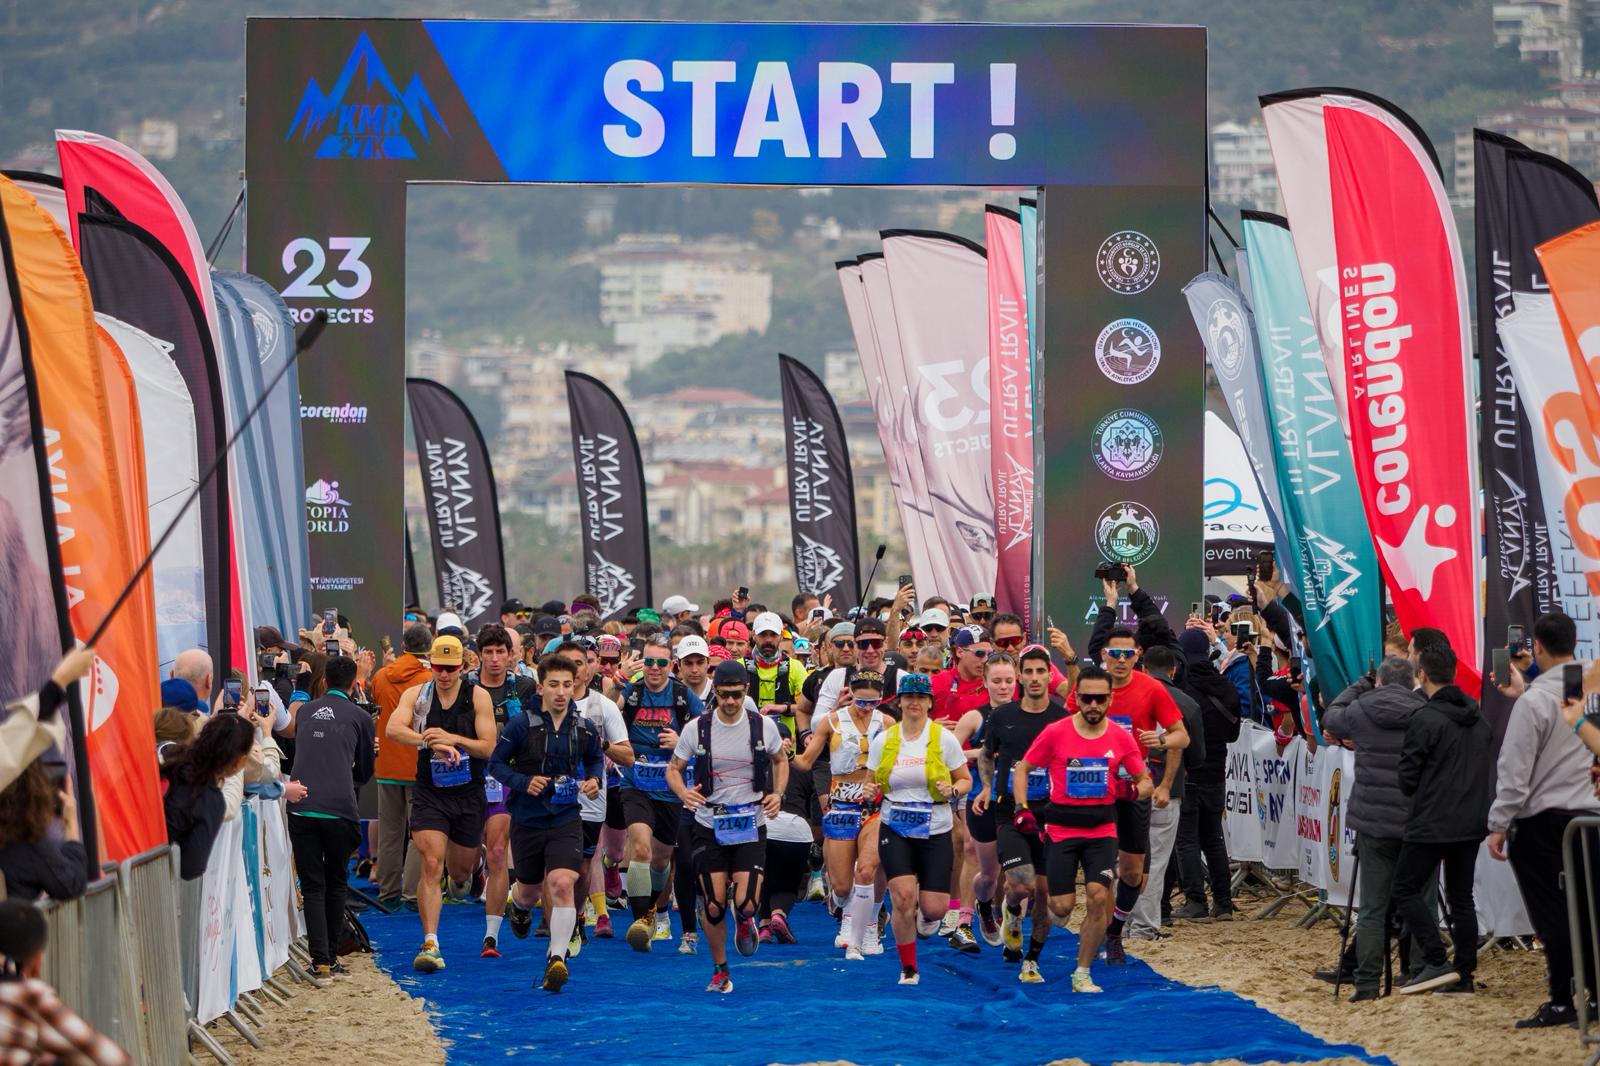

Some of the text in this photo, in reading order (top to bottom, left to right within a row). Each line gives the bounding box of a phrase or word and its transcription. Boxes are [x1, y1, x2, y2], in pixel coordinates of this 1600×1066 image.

[602, 59, 1017, 160] START !
[338, 104, 404, 135] KMR
[338, 136, 386, 159] 27K
[280, 237, 372, 300] 23
[288, 308, 374, 324] ROECTS
[300, 403, 368, 418] corendon
[1095, 454, 1115, 475] ALANYA
[306, 506, 349, 518] OPIA
[307, 520, 349, 532] ORLD
[635, 708, 672, 722] RUN
[638, 768, 665, 778] 2174
[1070, 772, 1100, 783] 2001
[718, 817, 748, 831] 2147
[825, 815, 856, 826] 2044
[891, 810, 925, 824] 2095
